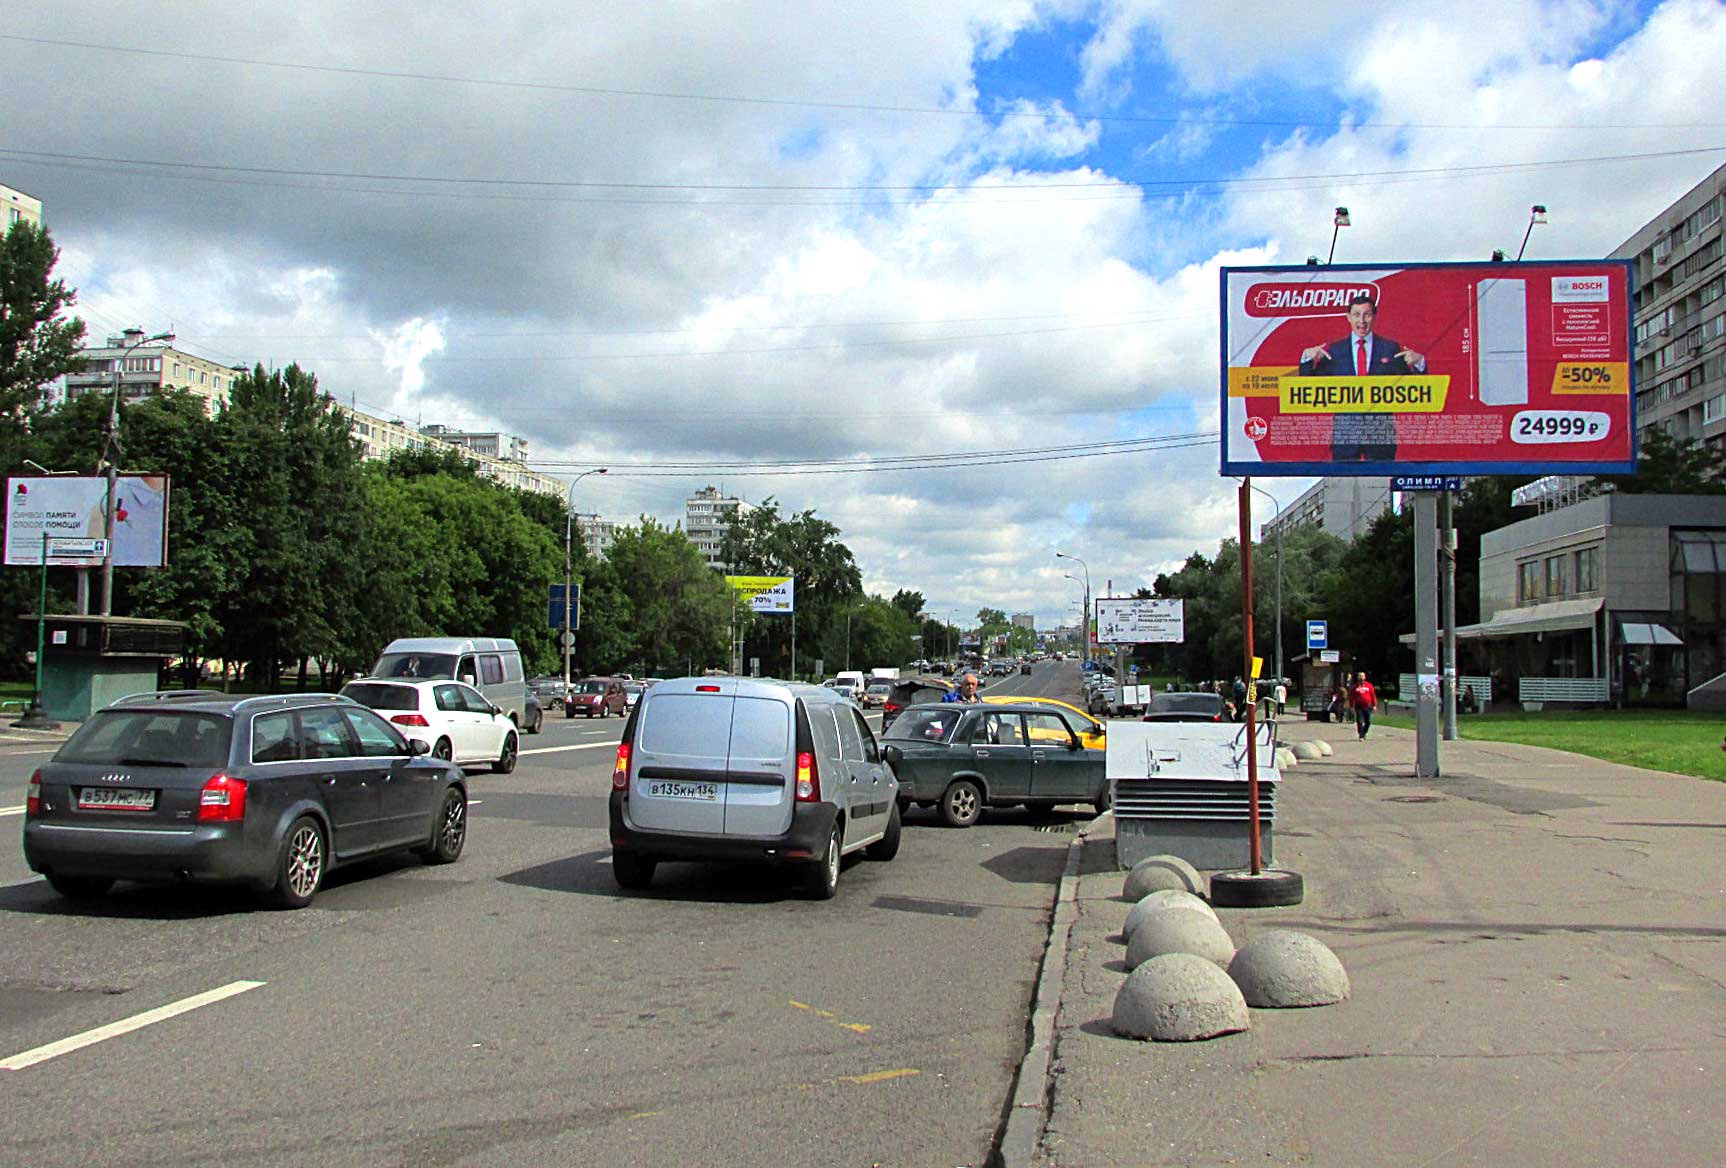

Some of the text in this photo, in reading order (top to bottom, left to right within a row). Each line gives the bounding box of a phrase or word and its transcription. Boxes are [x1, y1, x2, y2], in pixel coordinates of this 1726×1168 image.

[1572, 282, 1602, 290] BOSCH
[1290, 385, 1432, 407] НЕДЕЛИ BOSCH
[1519, 417, 1585, 436] 24999
[1397, 477, 1442, 485] ОЛИМП
[46, 511, 76, 519] ПАМЯТИ
[12, 521, 80, 530] СПОСОБ ПОМОЩИ
[697, 785, 714, 795] 134
